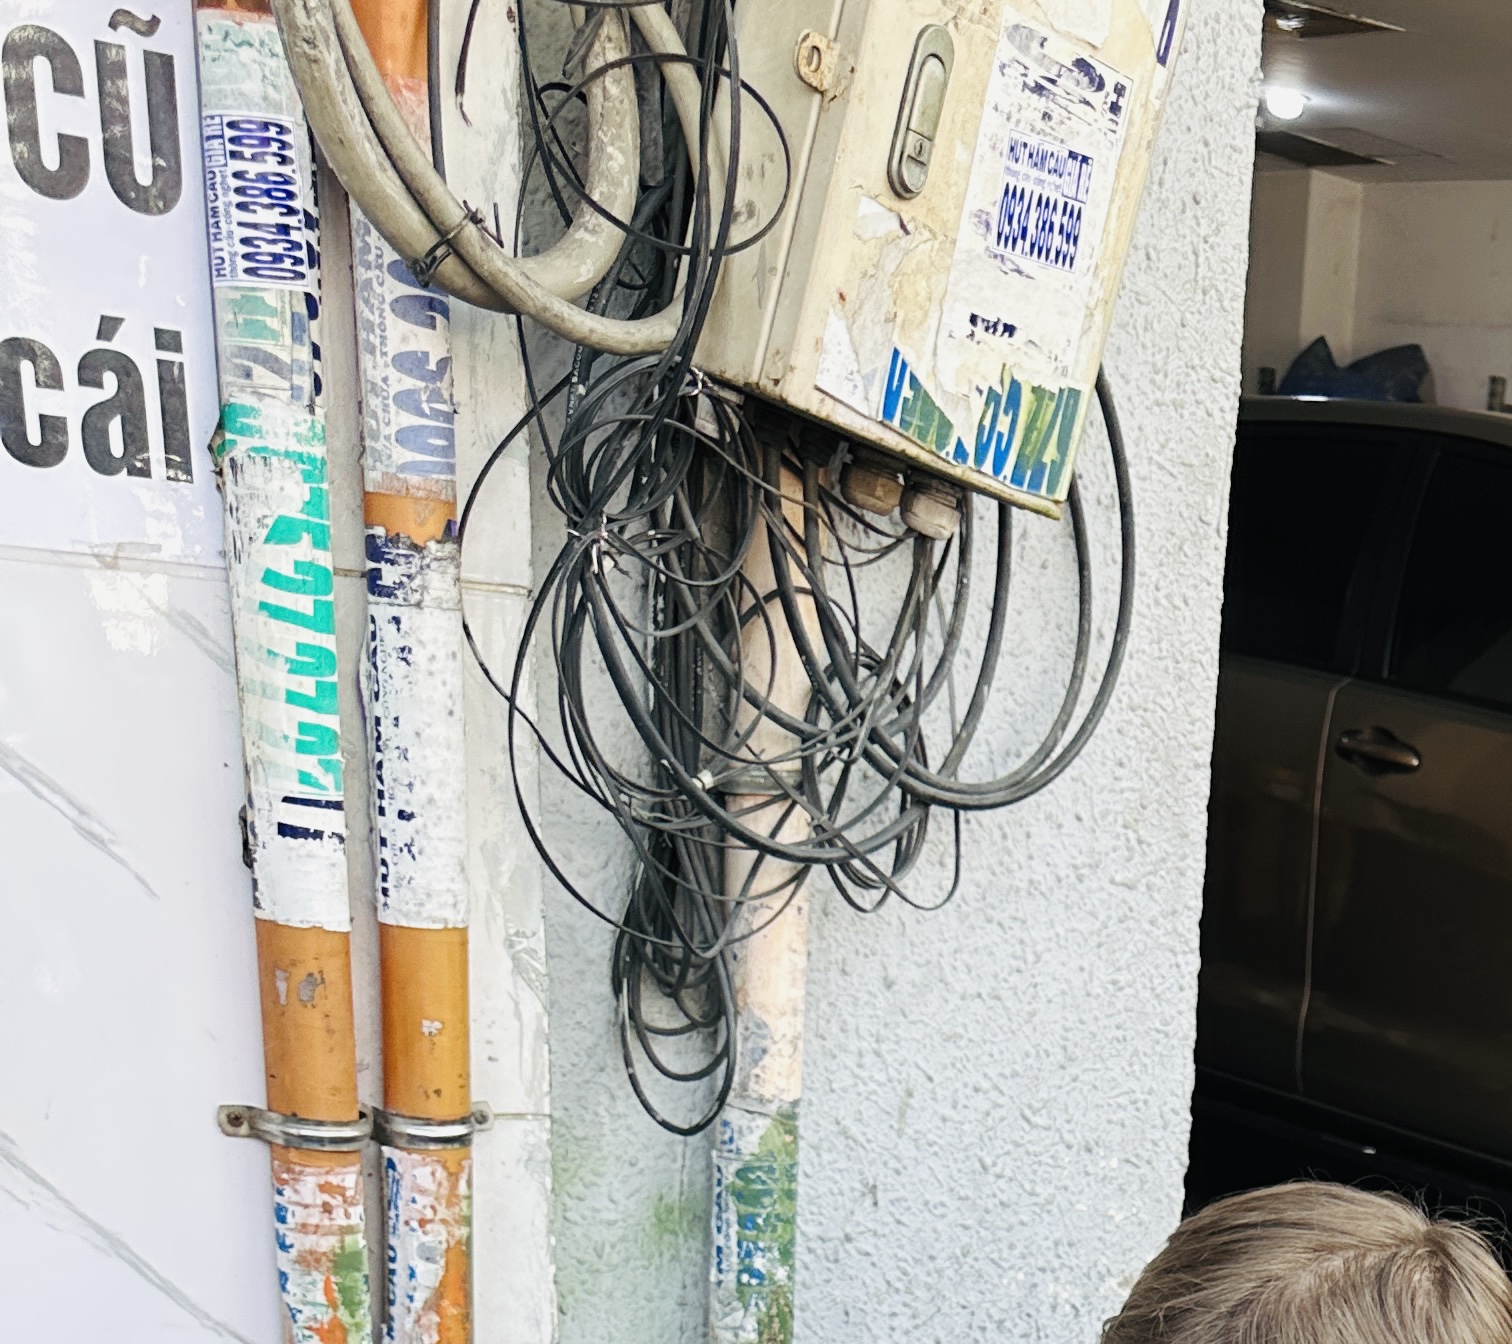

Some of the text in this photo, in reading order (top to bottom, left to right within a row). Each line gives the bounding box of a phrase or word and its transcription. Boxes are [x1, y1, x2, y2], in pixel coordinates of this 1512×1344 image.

[226, 119, 306, 280] 0934.386.599
[996, 181, 1082, 270] 0934.386.599
[0, 315, 194, 484] cái
